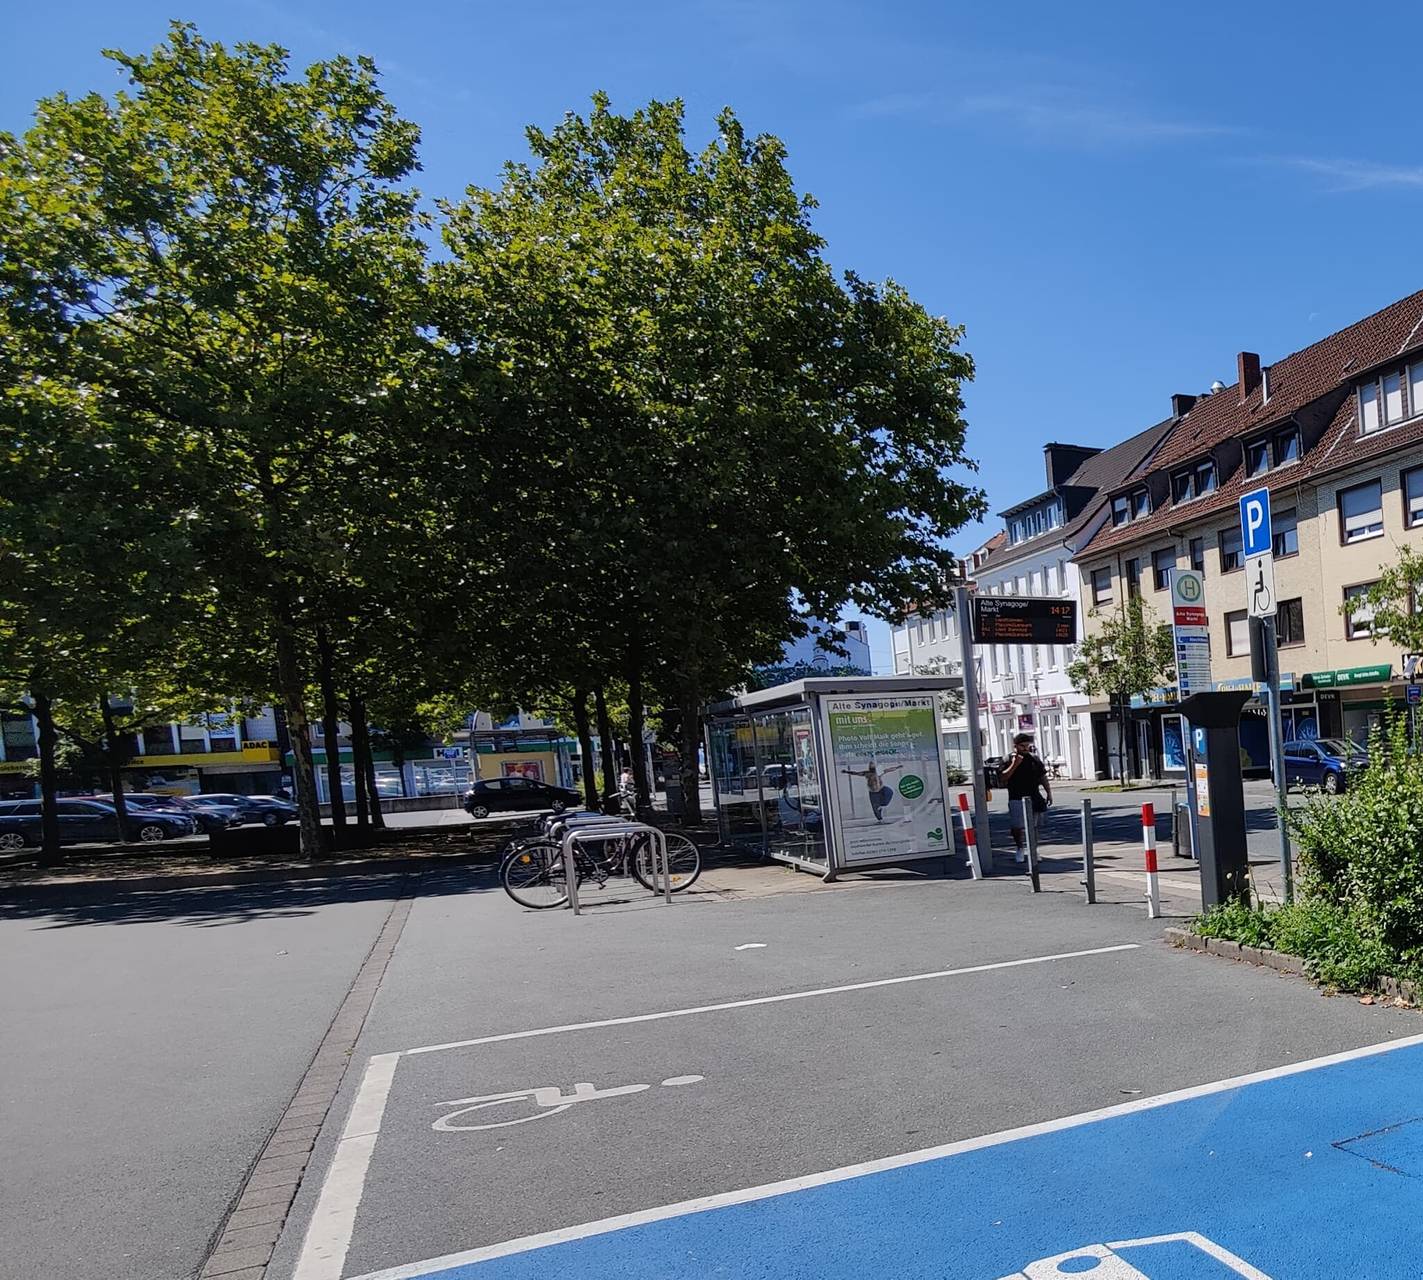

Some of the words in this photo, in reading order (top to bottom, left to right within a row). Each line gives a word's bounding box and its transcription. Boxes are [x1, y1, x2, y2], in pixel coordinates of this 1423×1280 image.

[1247, 500, 1263, 548] P
[1185, 580, 1195, 596] H
[833, 702, 851, 710] Alte
[835, 715, 851, 725] mit
[243, 741, 268, 749] ADAC
[1195, 728, 1203, 749] P
